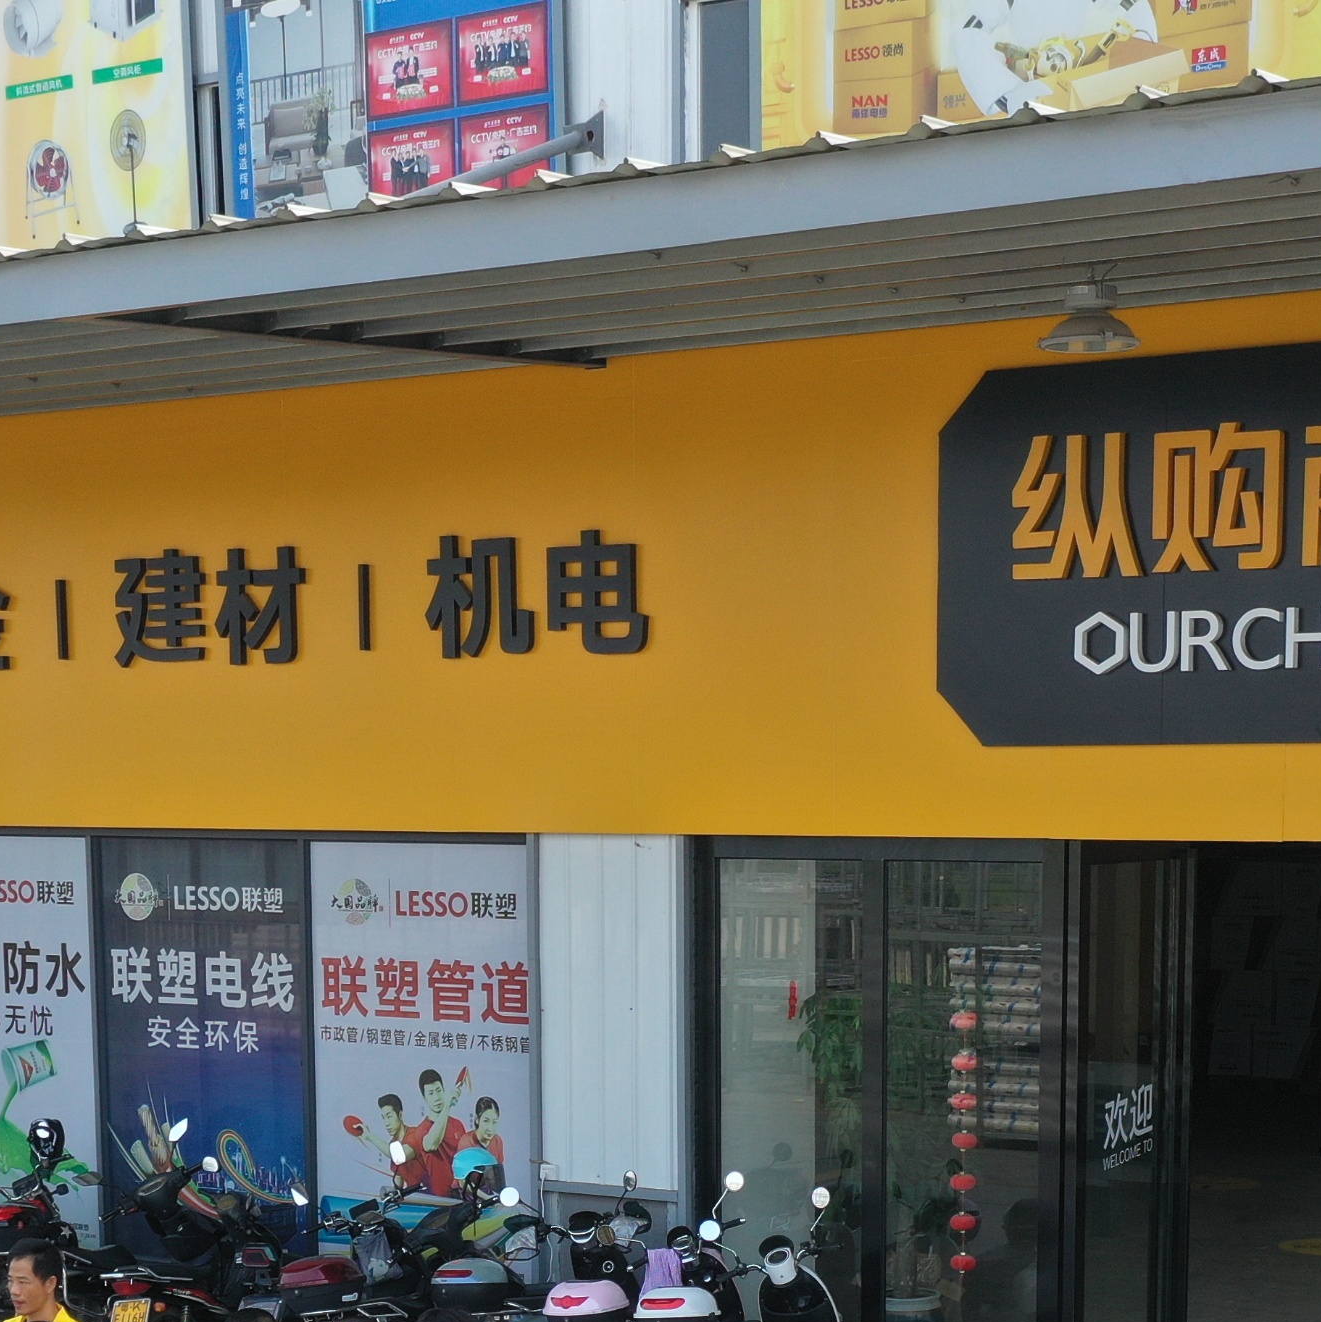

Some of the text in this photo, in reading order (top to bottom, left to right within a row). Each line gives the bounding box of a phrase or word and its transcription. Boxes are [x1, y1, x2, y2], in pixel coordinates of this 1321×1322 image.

[844, 43, 904, 62] LESSO 领尚
[1197, 48, 1220, 63] 东成
[113, 65, 142, 79] 空调风柜
[235, 72, 246, 130] 点亮未来
[851, 94, 889, 108] NAN
[113, 546, 307, 668] 建材
[424, 528, 651, 660] 机电
[36, 880, 75, 906] 联塑
[173, 885, 284, 914] LESSO 联塑
[395, 890, 517, 920] LESSO 联塑
[110, 946, 295, 1012] 联塑电线
[320, 955, 530, 1025] 联塑管道
[147, 1015, 260, 1054] 安全环保
[1103, 1084, 1153, 1150] 欢迎
[1102, 1138, 1153, 1171] WELCOME TO
